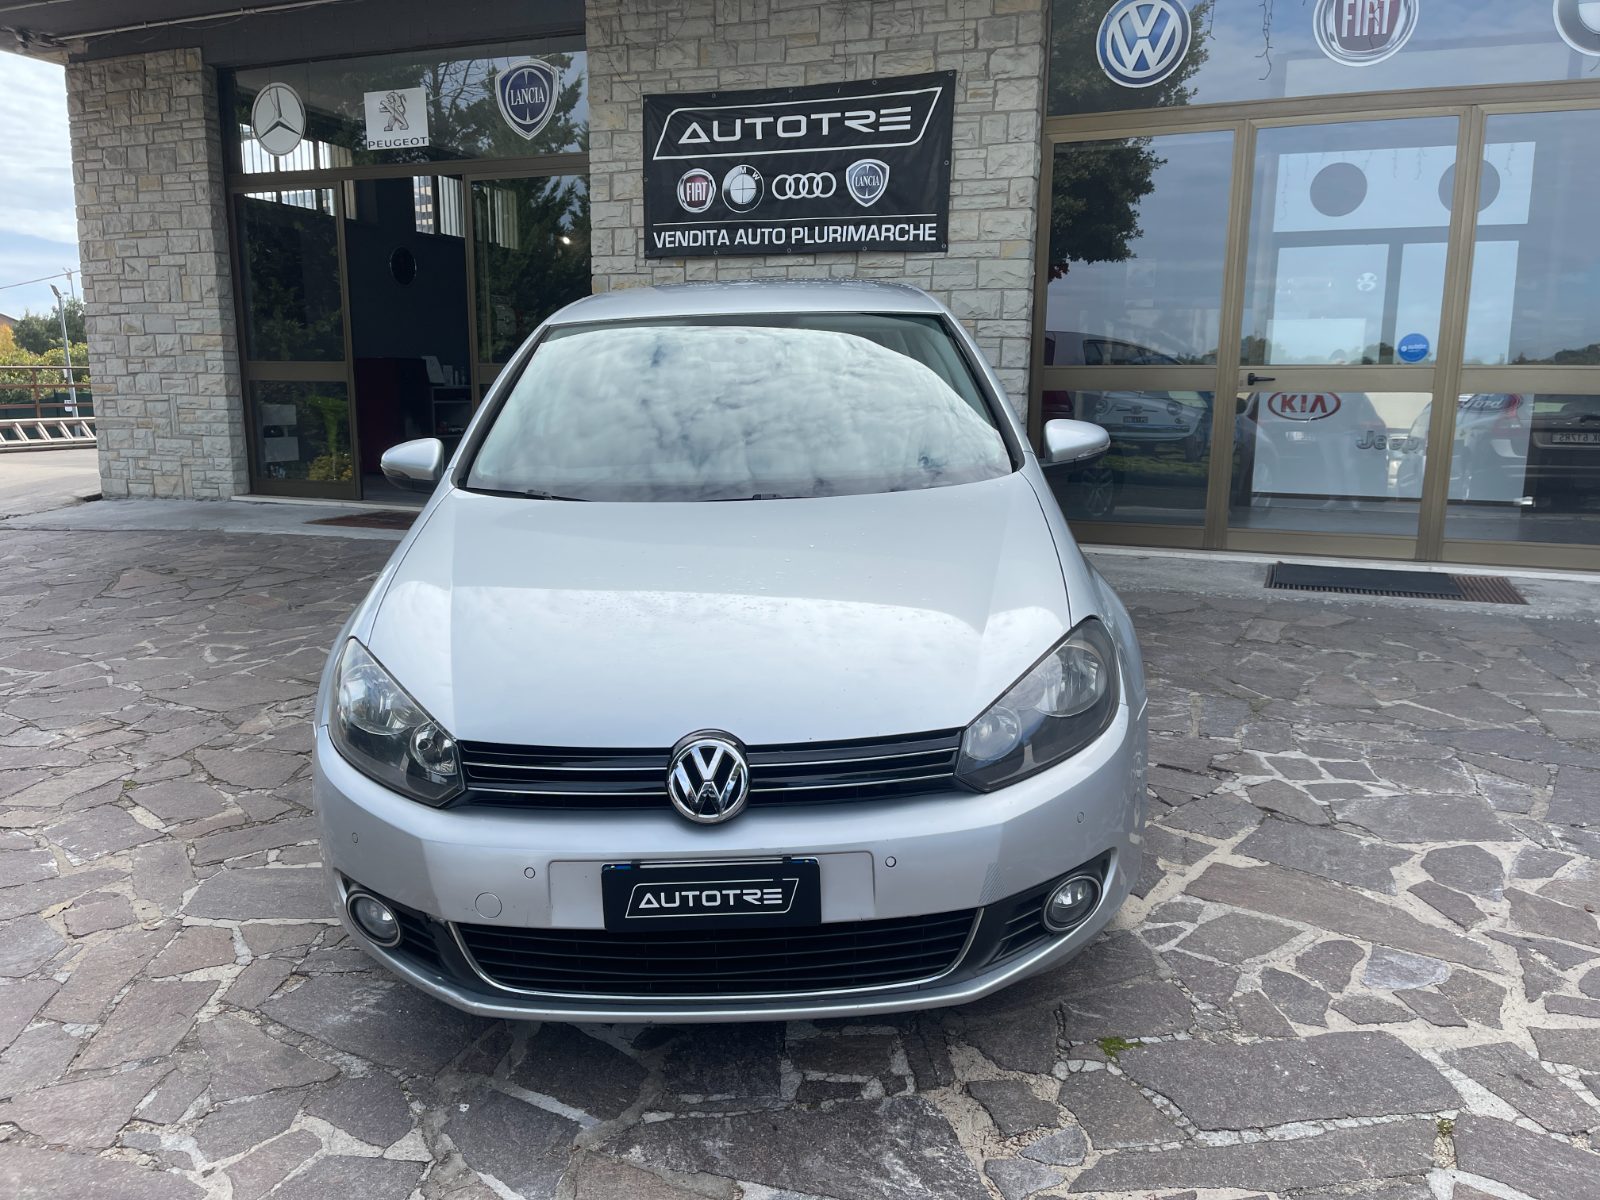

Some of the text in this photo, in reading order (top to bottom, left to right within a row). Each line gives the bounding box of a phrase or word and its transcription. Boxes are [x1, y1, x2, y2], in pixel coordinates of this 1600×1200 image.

[1341, 0, 1392, 38] FIAT
[1108, 2, 1180, 76] VW
[510, 87, 545, 107] LANCIA
[678, 106, 912, 144] AUTOTRE
[368, 136, 428, 149] PEUGEOT
[686, 181, 708, 202] FIAT
[854, 175, 880, 187] LANCIA
[653, 223, 937, 249] VENDITA AUTO PLURIMARCHE
[1281, 394, 1328, 413] KIA
[1356, 430, 1419, 454] Jeep
[672, 742, 747, 819] VW
[638, 888, 783, 909] AUTOTRE
